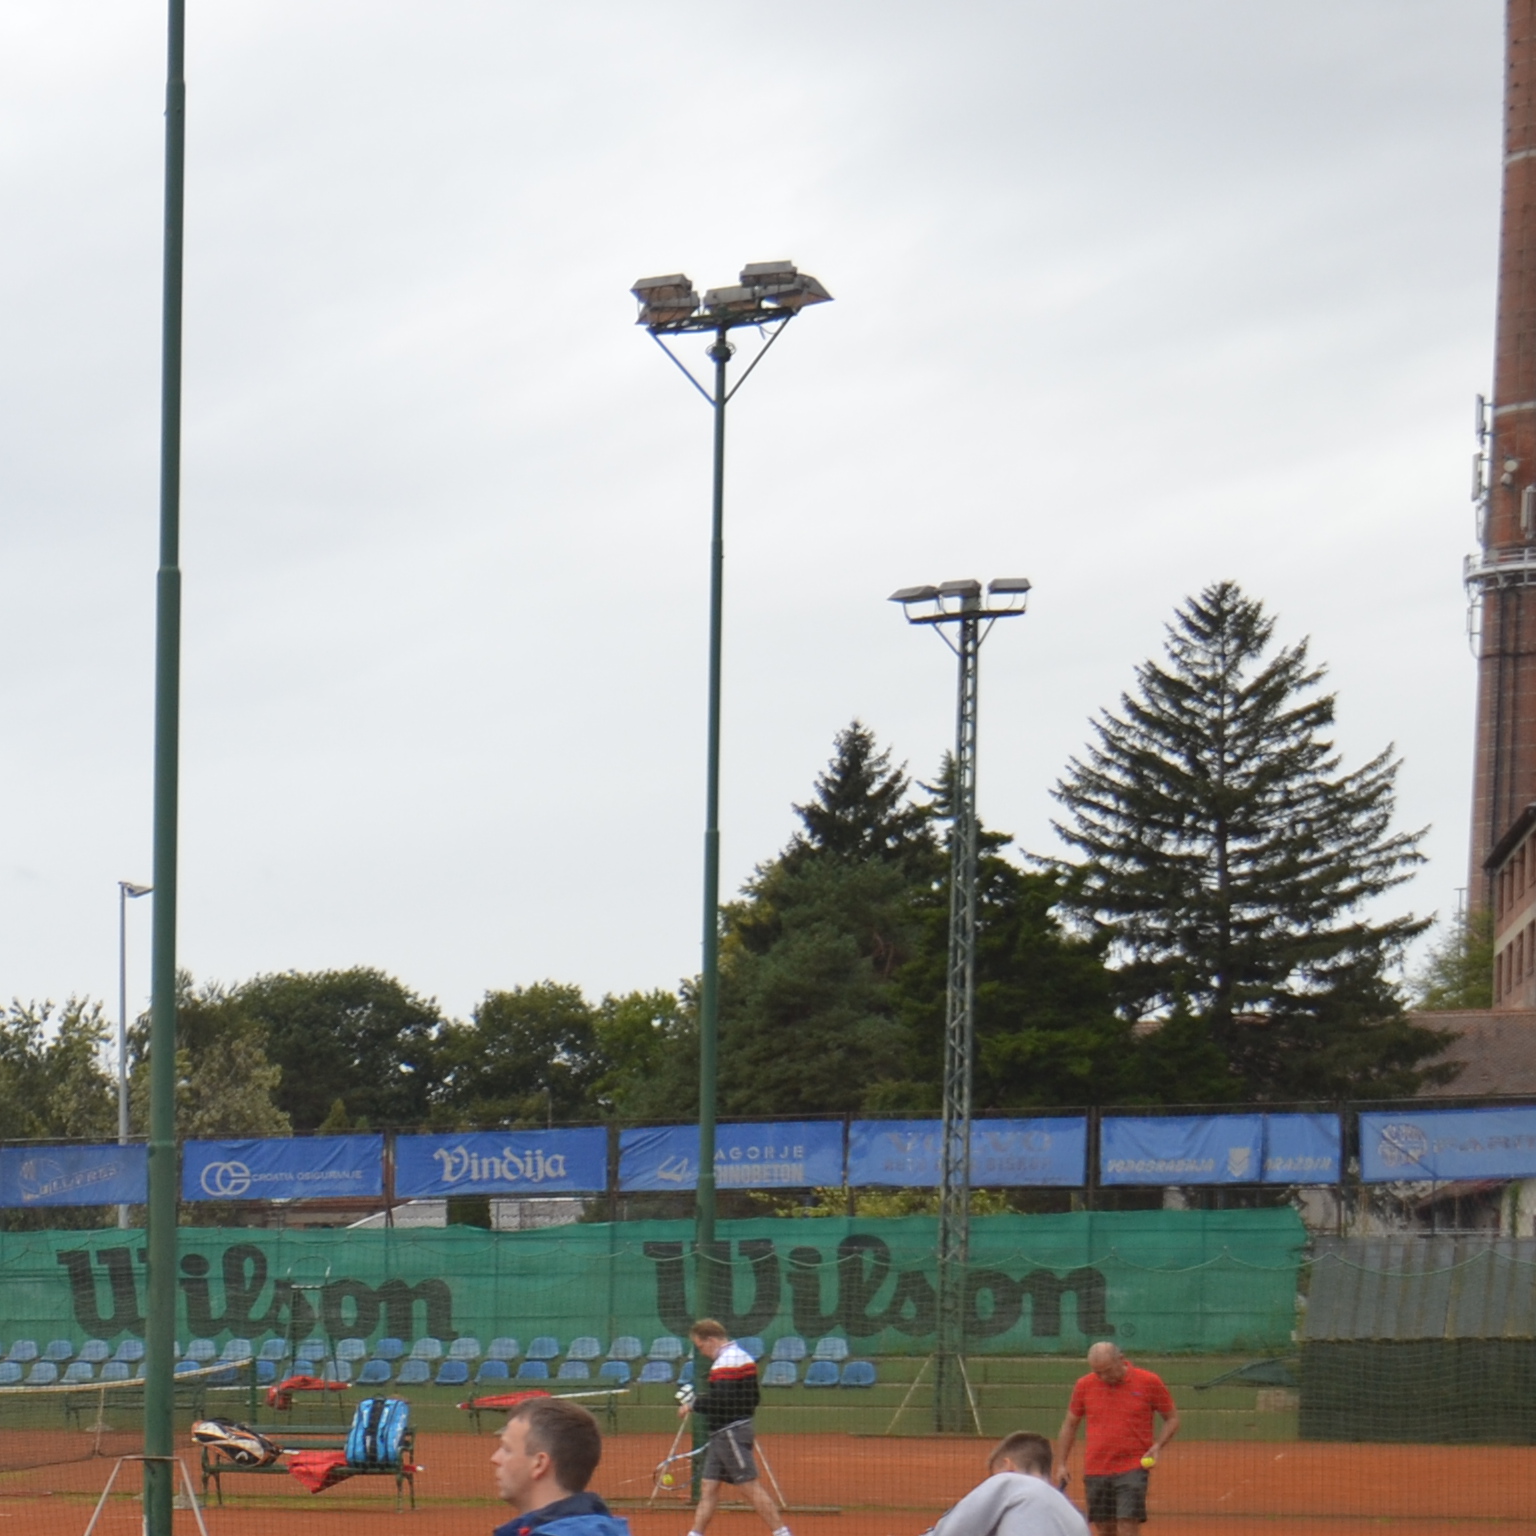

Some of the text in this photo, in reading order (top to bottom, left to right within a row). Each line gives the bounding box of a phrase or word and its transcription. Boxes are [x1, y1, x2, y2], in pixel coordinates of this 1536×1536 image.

[432, 1145, 567, 1183] Vindija
[713, 1145, 804, 1161] AGORJE
[1264, 1154, 1333, 1172] ARAŽDIN
[252, 1172, 294, 1182] CROATIA
[56, 1243, 460, 1342] Wilson
[644, 1233, 1116, 1339] Wilson
